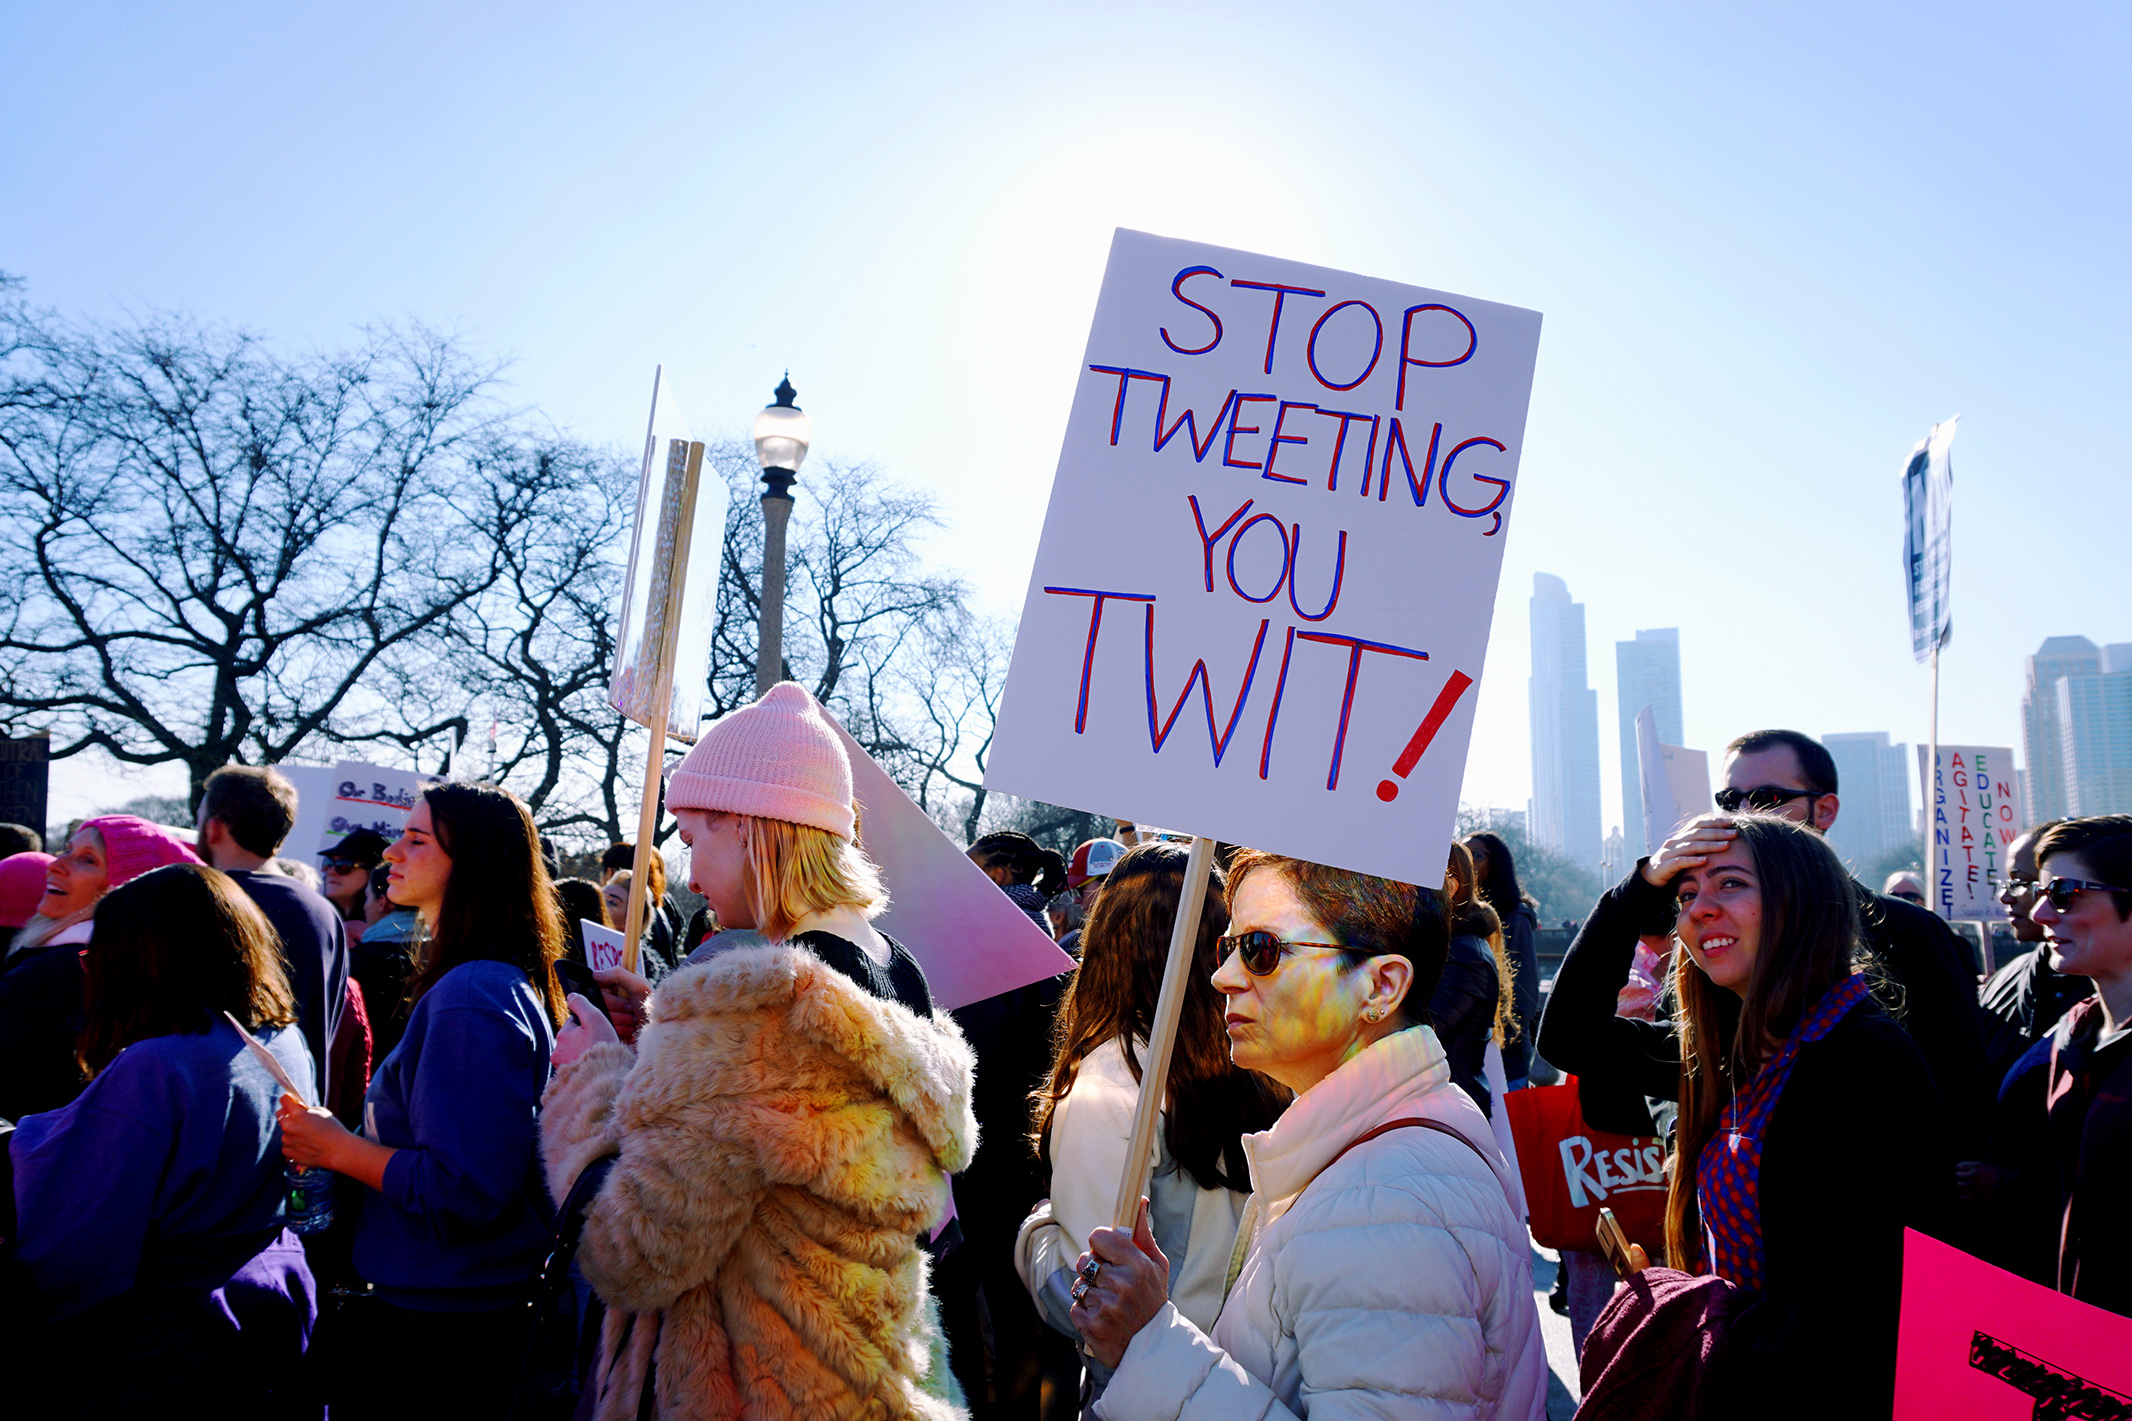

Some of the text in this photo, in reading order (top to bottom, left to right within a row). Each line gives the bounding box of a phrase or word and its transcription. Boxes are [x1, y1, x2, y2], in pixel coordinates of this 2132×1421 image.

[1159, 265, 1477, 411] STOP
[1089, 364, 1511, 536] TWEETING,
[1187, 495, 1347, 622] YOU
[1044, 586, 1474, 803] TWIT!
[1952, 752, 1979, 900] AGITATE!
